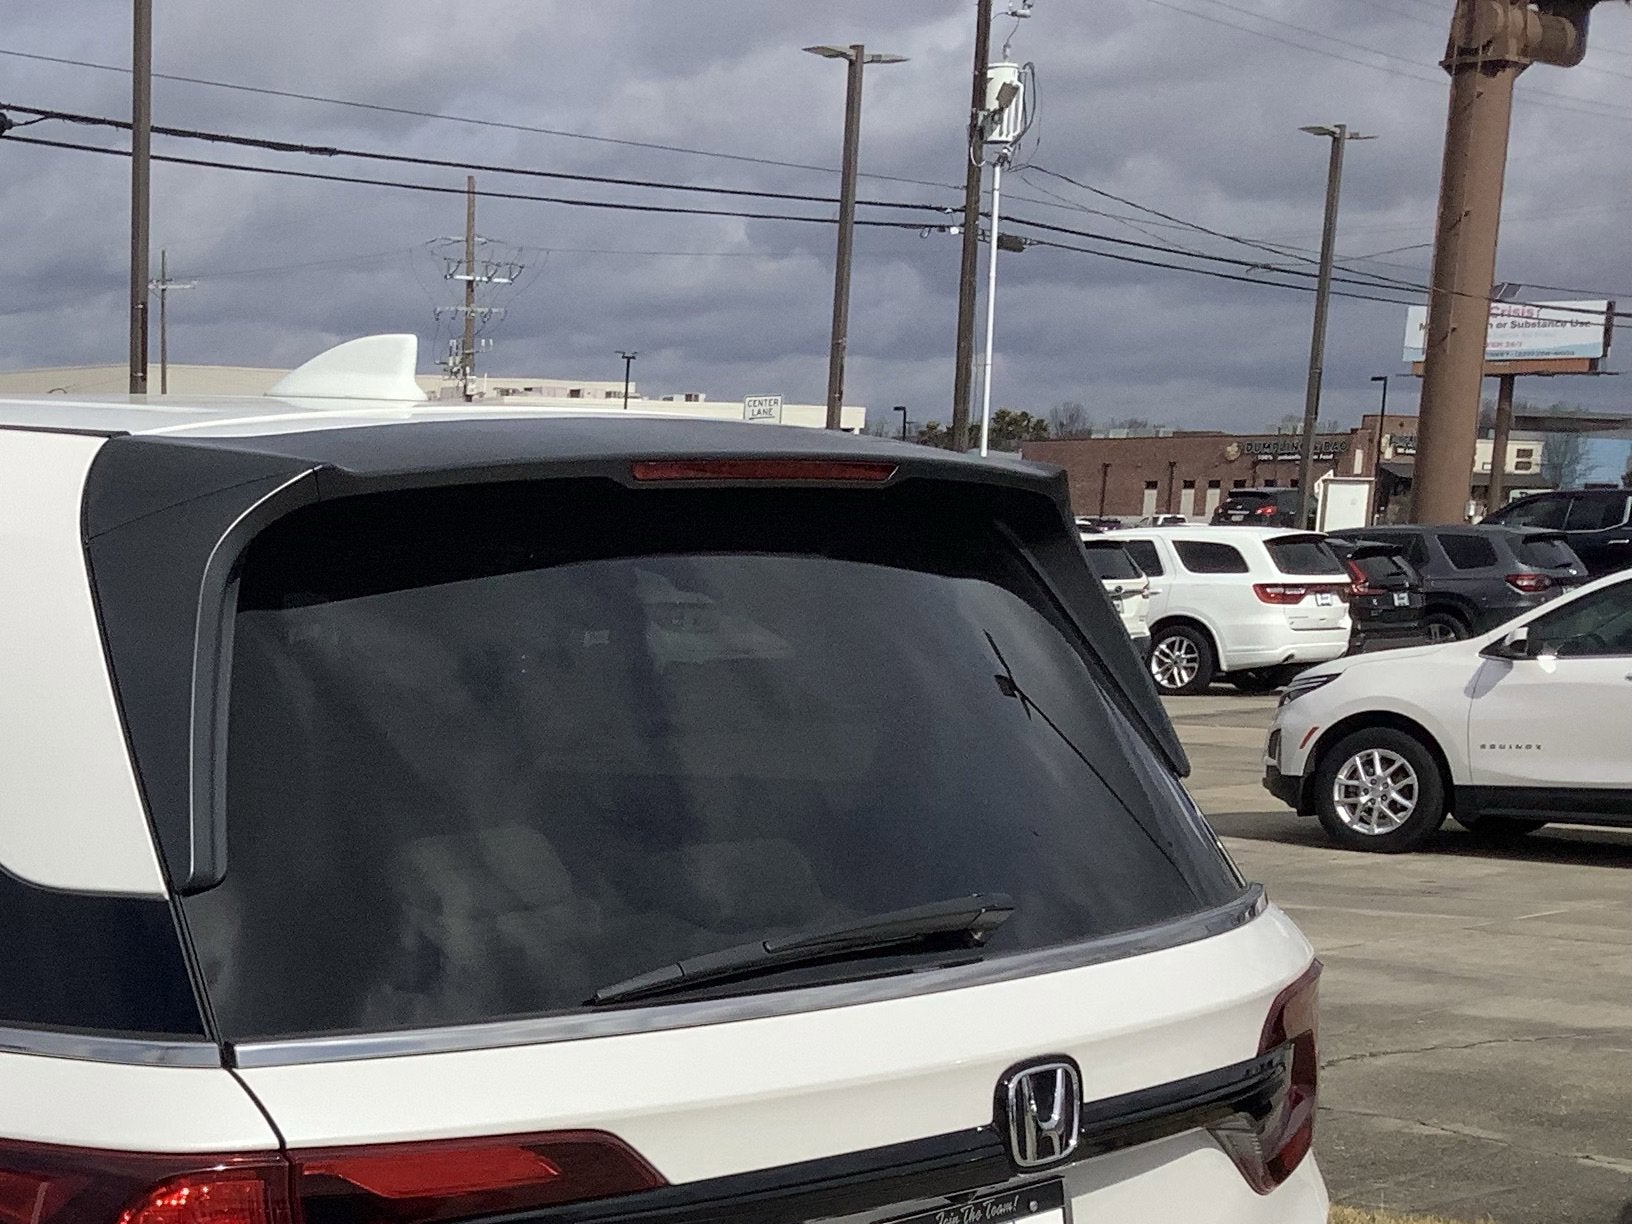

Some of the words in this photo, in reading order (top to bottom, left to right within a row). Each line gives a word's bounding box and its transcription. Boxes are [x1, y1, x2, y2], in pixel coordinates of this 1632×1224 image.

[1510, 319, 1567, 330] Substance
[748, 399, 779, 408] CENTER
[751, 408, 773, 417] LANE
[982, 1195, 1019, 1220] Team!
